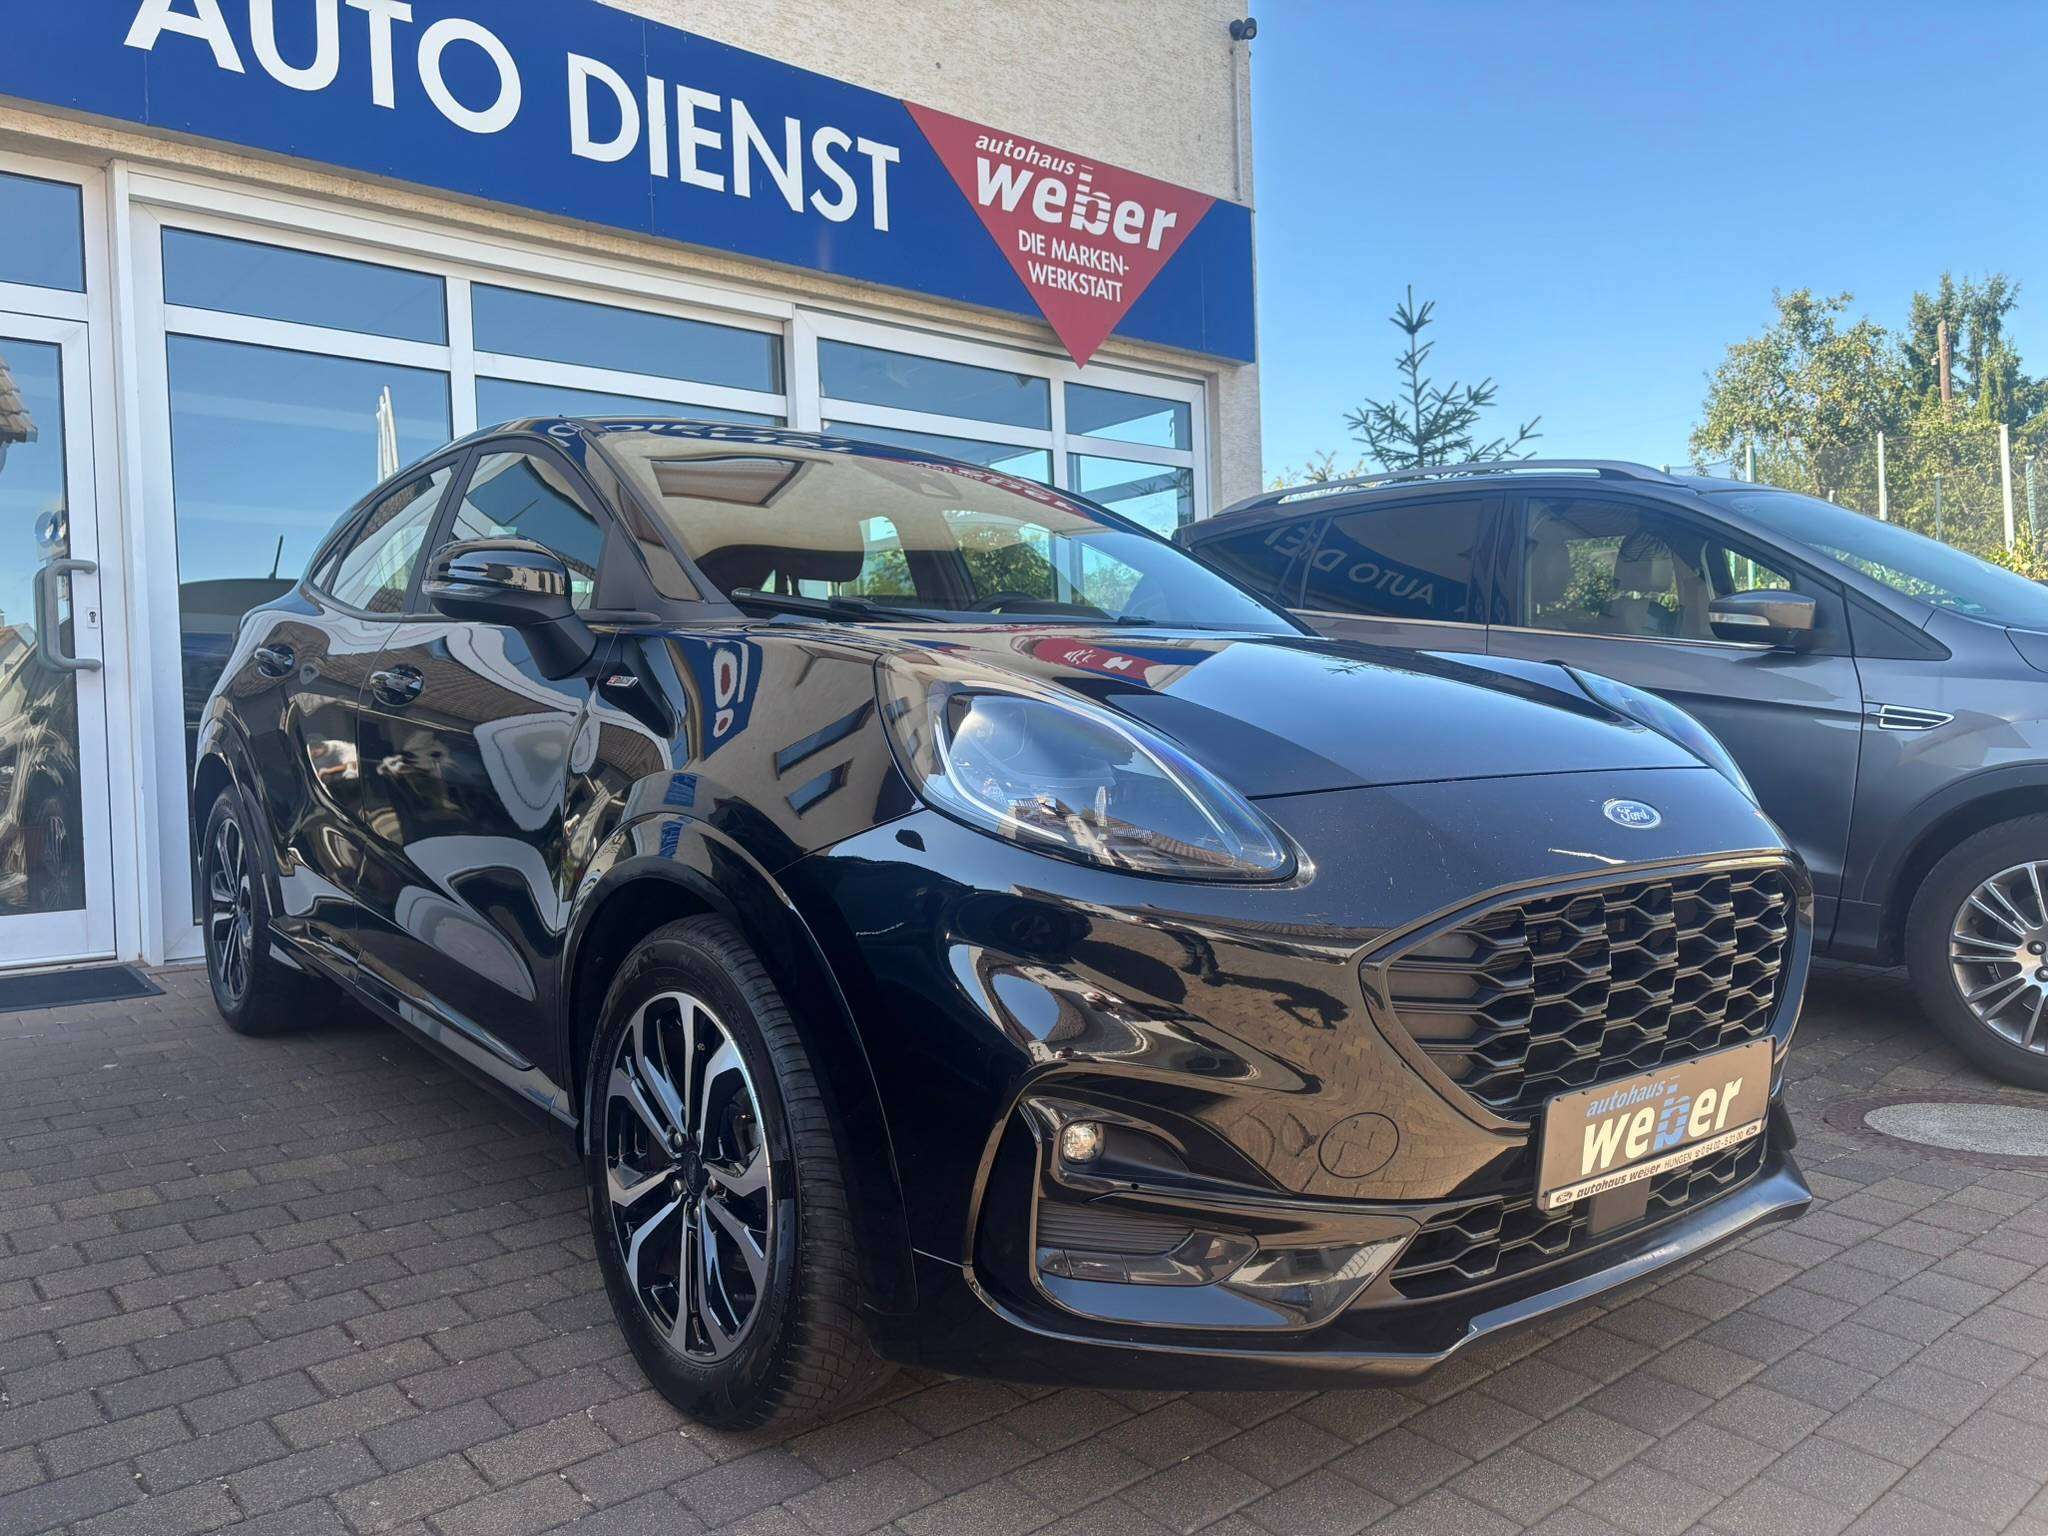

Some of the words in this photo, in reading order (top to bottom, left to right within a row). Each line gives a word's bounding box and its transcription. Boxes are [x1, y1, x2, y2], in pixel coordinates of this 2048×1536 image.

[567, 52, 901, 232] DIENST
[975, 135, 1076, 176] autohaus
[976, 156, 1178, 251] weber
[1018, 229, 1046, 256] DIE
[1051, 238, 1130, 276] MARKEN-
[1027, 260, 1123, 303] WERKSTATT
[1617, 806, 1650, 821] Ford
[1586, 1081, 1665, 1118] autohaus
[1577, 1175, 1627, 1198] autohaus
[1664, 1152, 1692, 1170] HUNGEN
